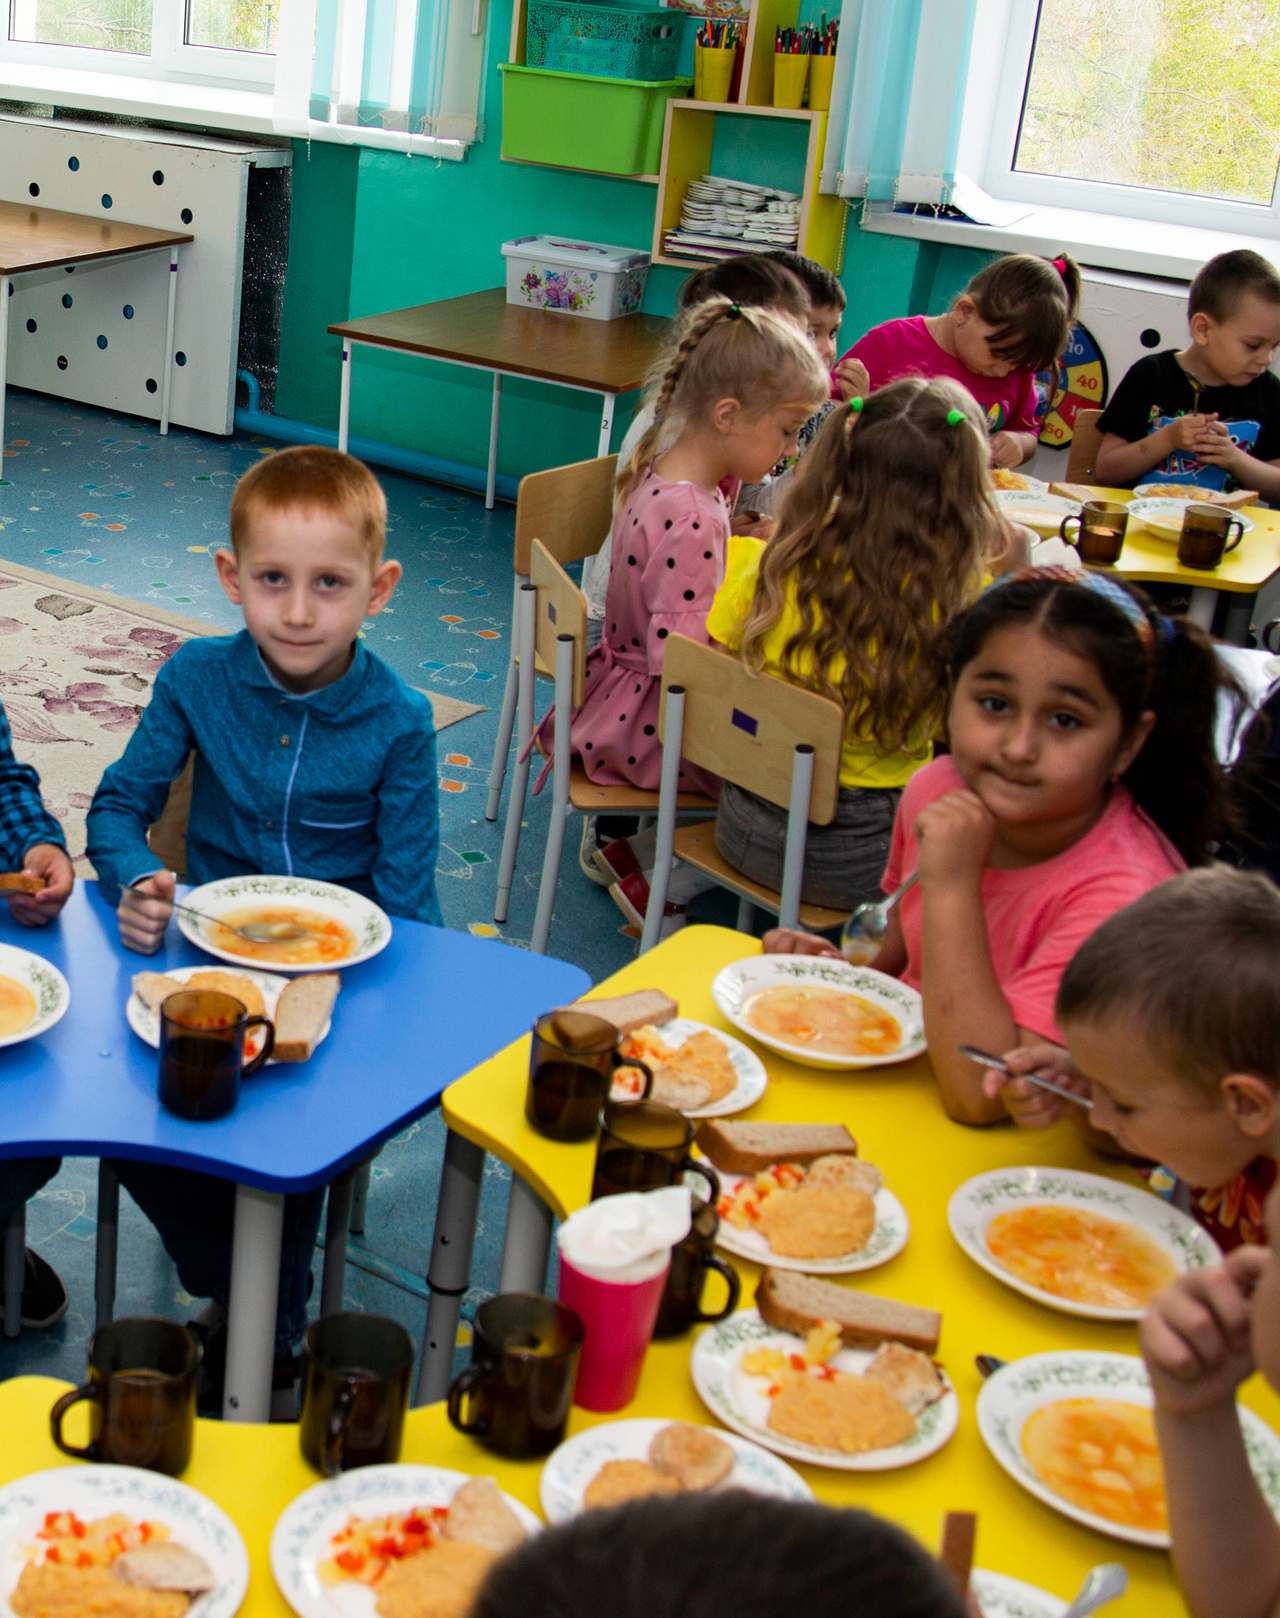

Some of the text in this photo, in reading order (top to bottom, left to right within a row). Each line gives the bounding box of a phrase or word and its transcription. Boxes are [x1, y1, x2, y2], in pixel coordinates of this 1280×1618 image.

[1076, 375, 1097, 390] 40
[602, 420, 609, 429] 2
[1044, 423, 1064, 439] 50
